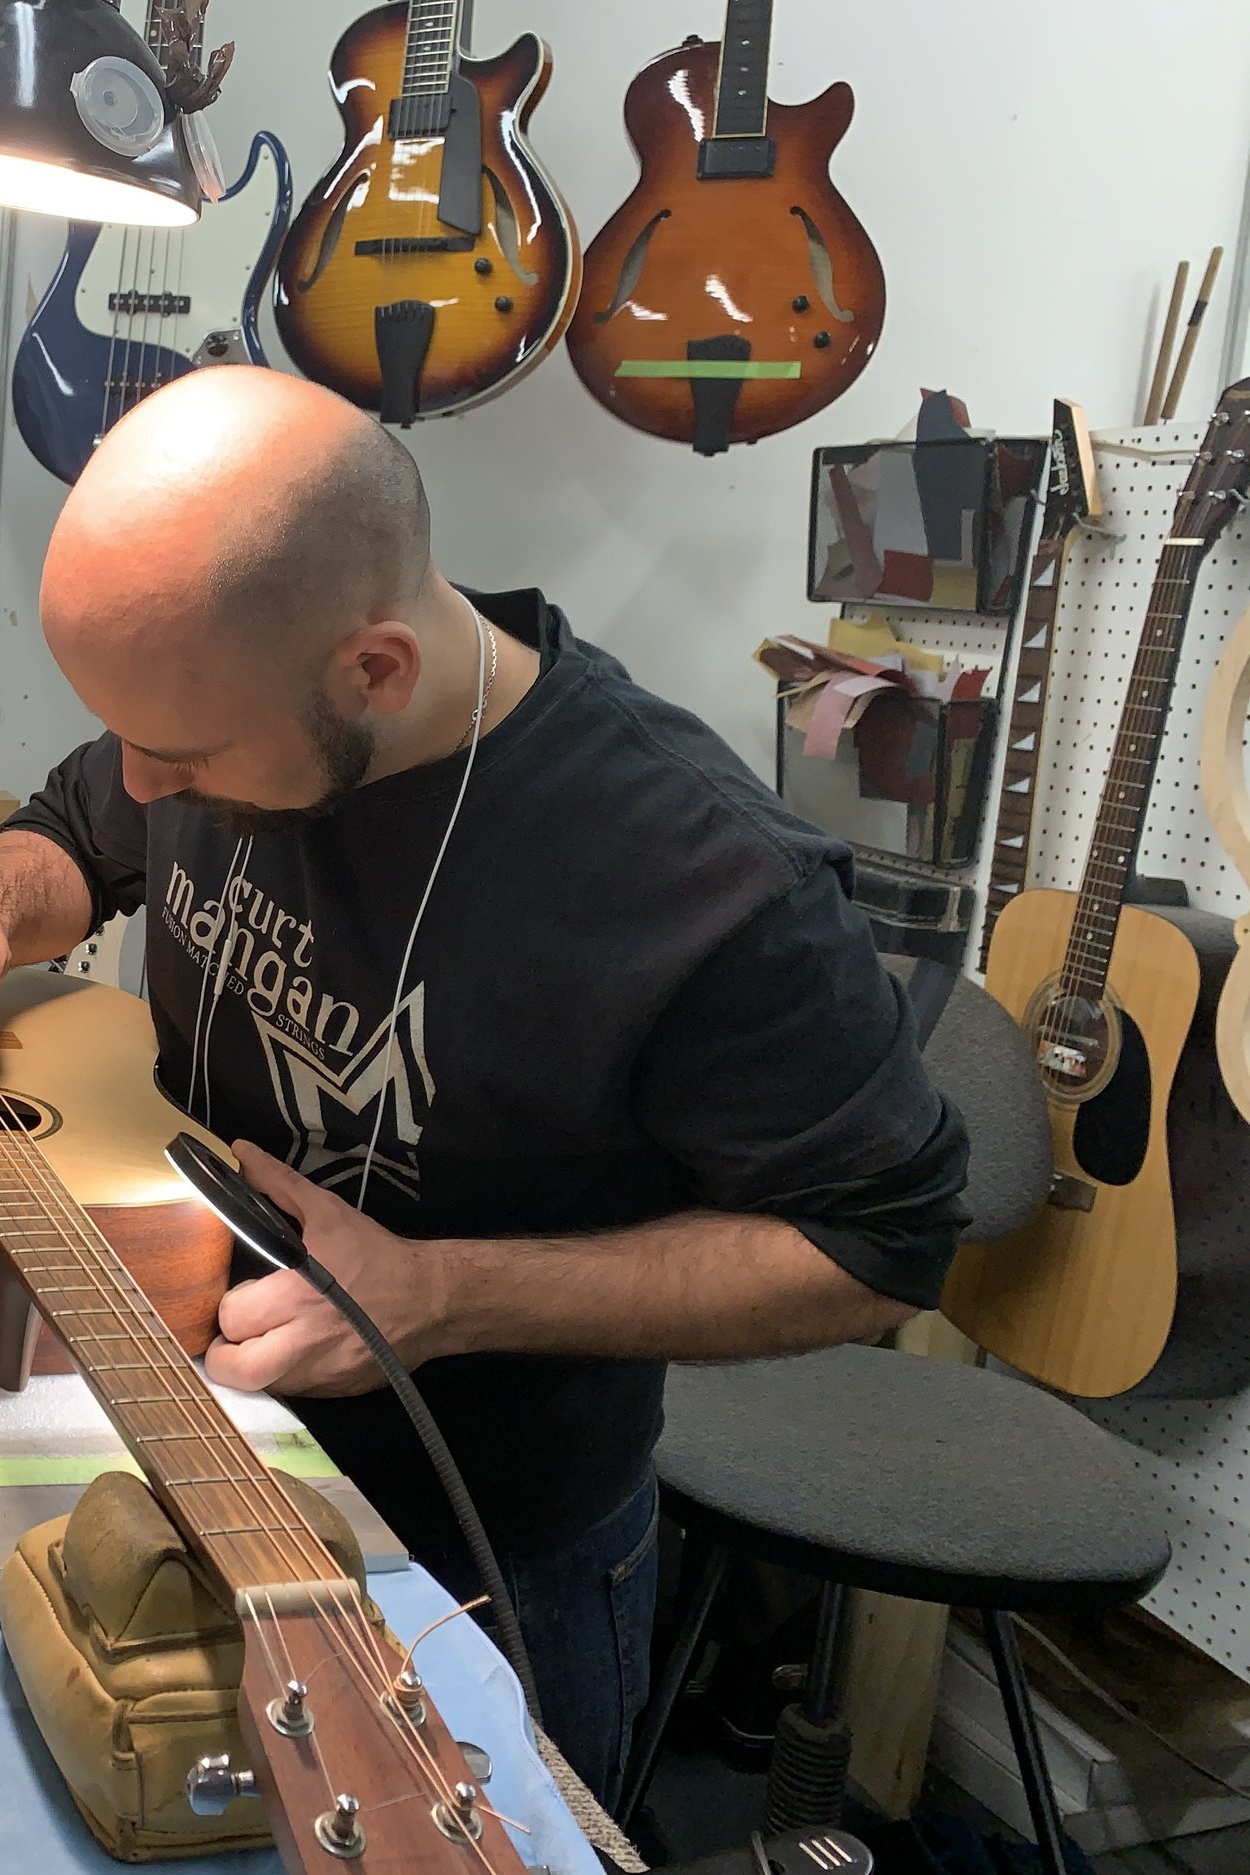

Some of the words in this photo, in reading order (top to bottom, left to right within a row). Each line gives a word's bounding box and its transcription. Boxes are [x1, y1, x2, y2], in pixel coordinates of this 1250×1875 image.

[161, 906, 187, 946] FUSION
[185, 940, 245, 995] MATCED
[275, 1013, 325, 1060] STRINGS
[166, 861, 360, 1056] mangan
[229, 875, 314, 968] curt
